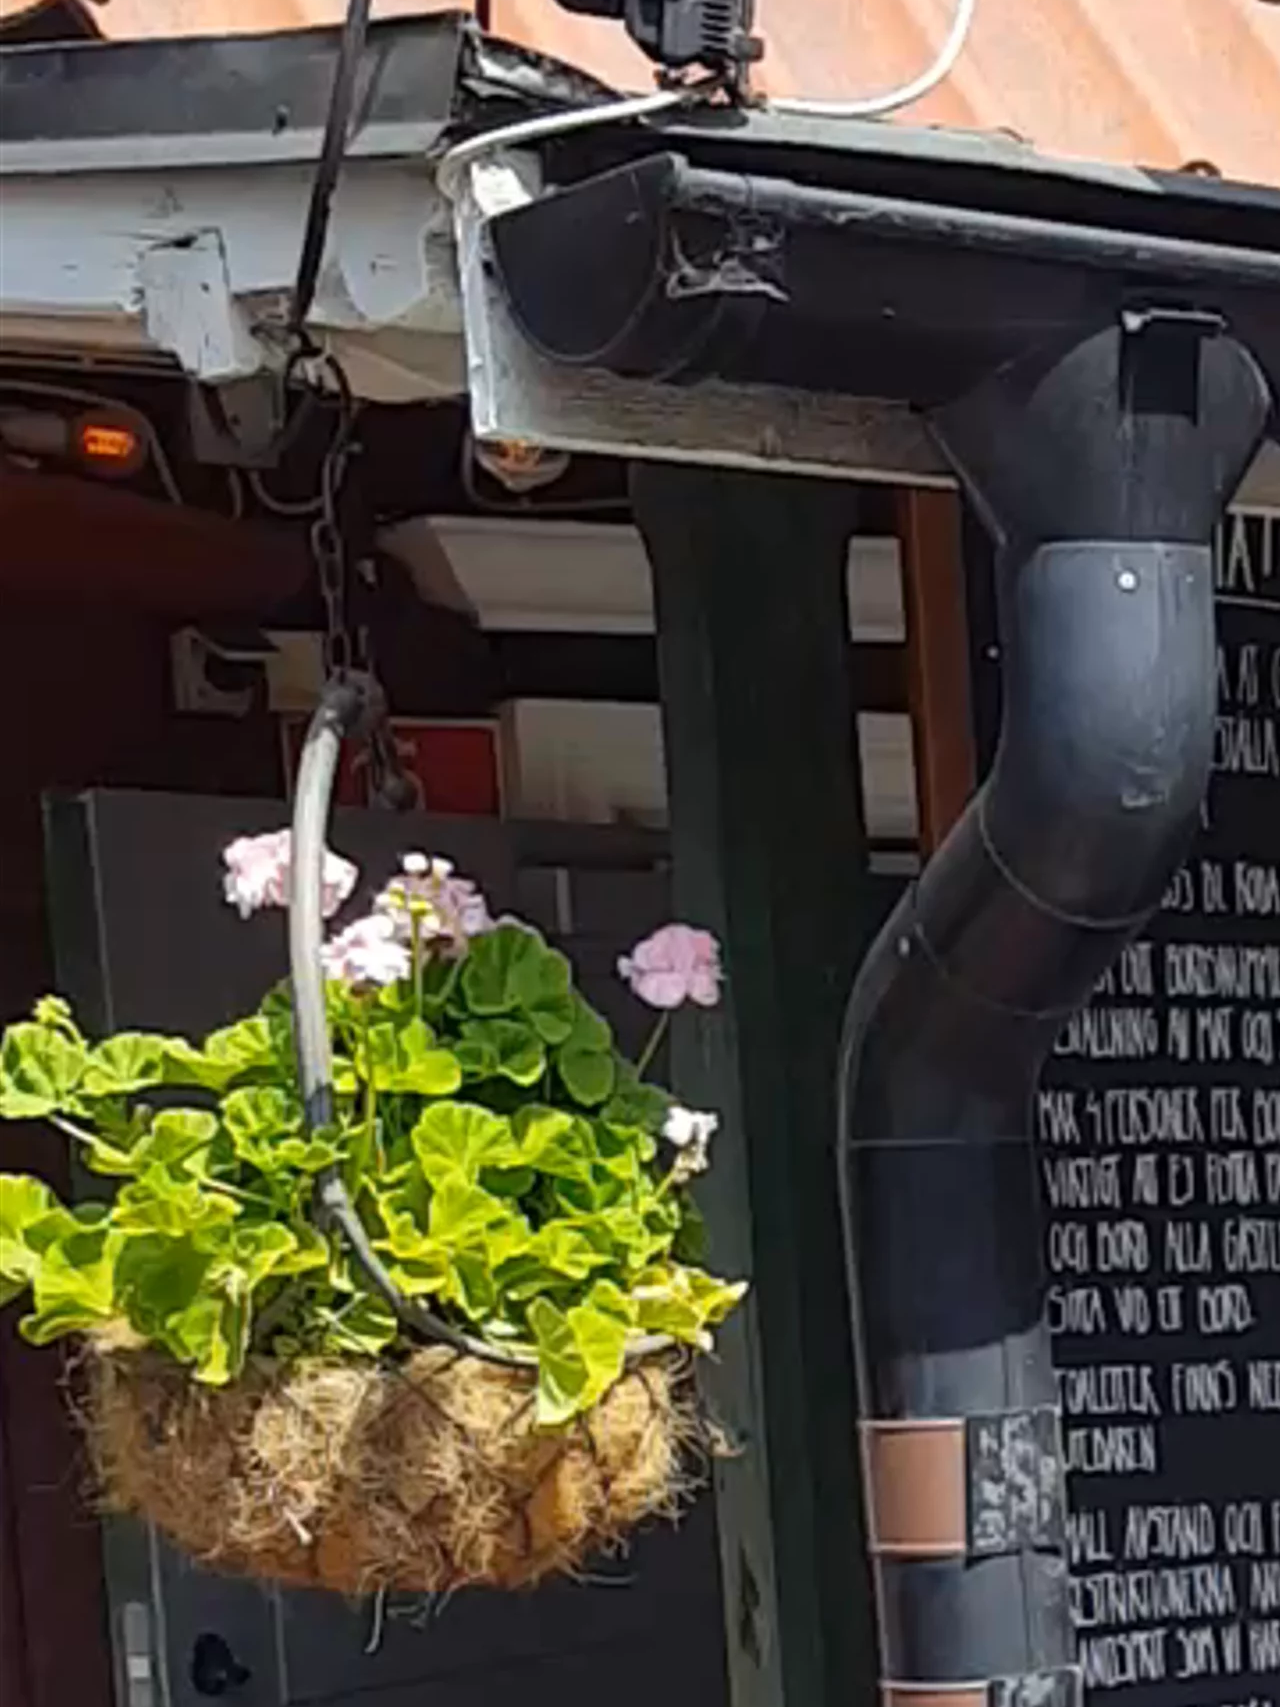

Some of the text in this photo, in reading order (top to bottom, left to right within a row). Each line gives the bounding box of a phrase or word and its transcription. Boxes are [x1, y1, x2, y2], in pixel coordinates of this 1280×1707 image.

[1210, 1088, 1248, 1143] PER
[1050, 1219, 1089, 1273] OCH
[1164, 1220, 1212, 1273] ALLA
[1114, 1284, 1151, 1335] VID
[1224, 1503, 1264, 1555] OCH
